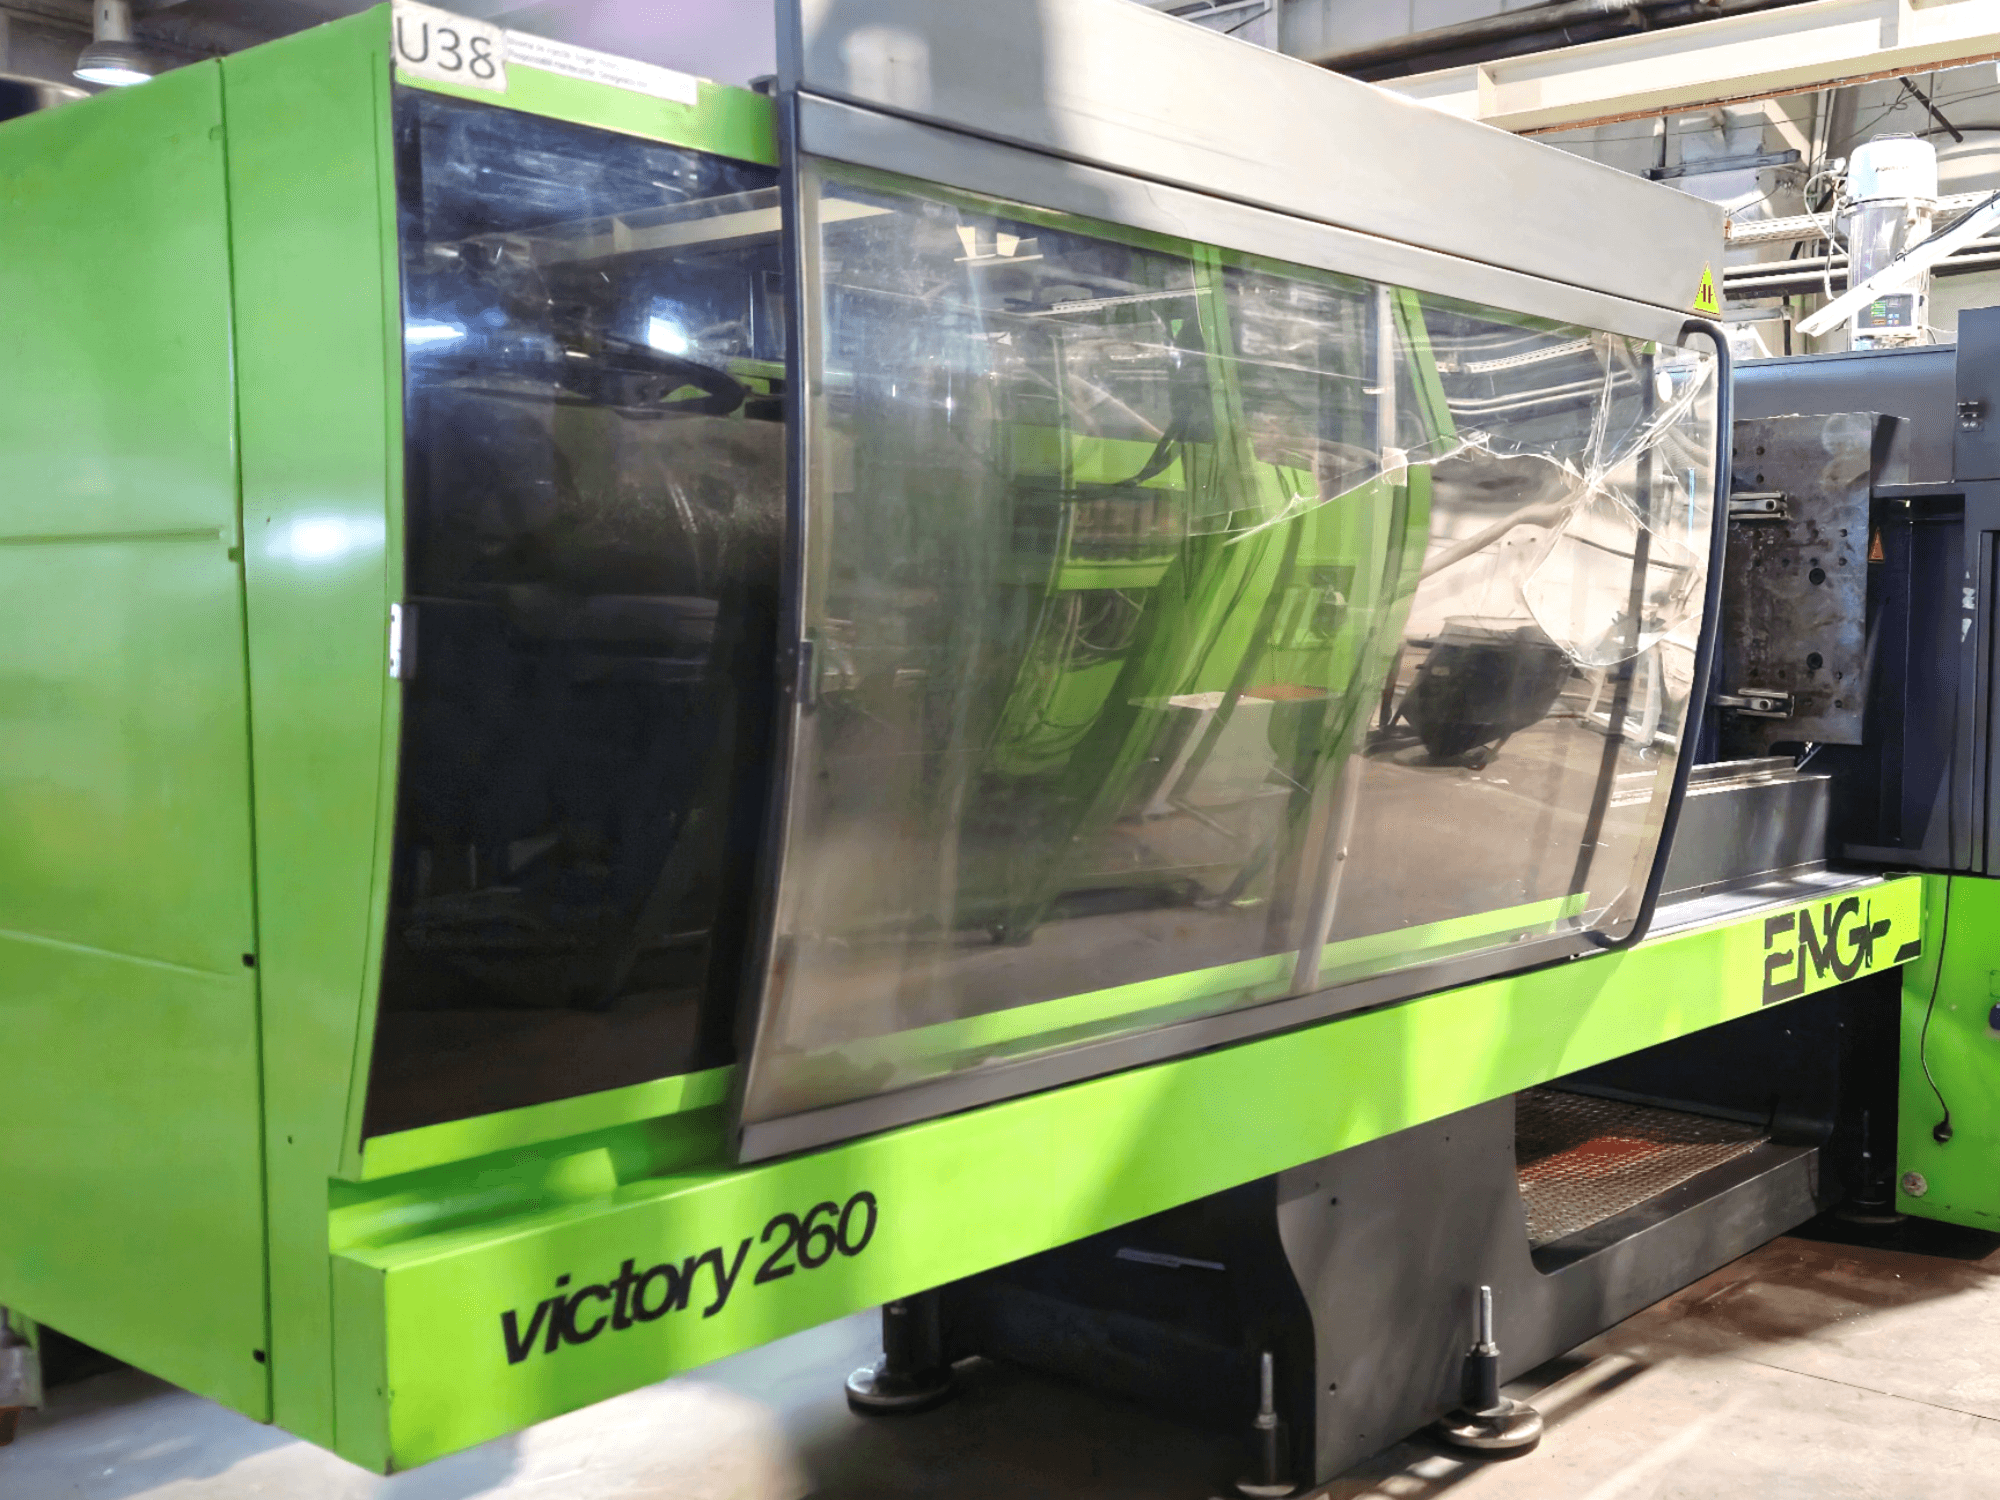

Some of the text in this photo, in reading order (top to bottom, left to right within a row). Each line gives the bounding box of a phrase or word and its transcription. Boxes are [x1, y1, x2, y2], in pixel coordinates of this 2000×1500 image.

[397, 16, 495, 80] U38
[501, 1191, 877, 1365] victory 260
